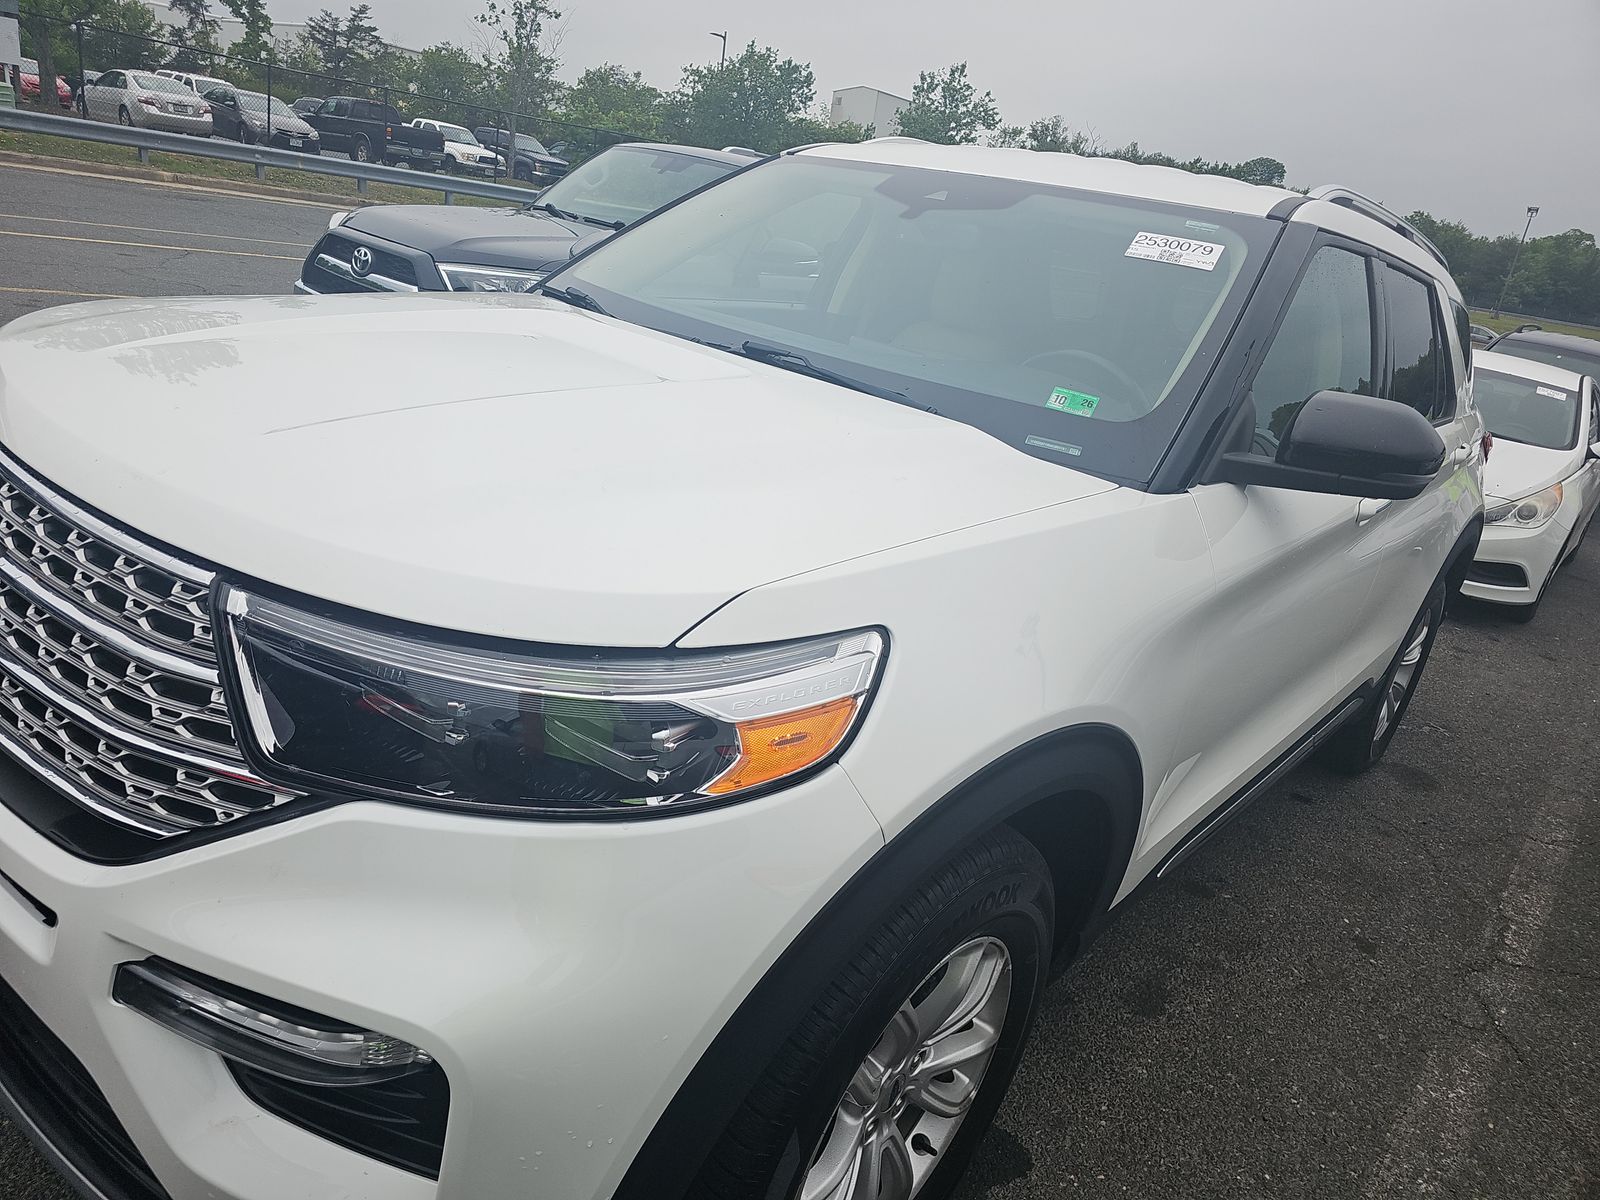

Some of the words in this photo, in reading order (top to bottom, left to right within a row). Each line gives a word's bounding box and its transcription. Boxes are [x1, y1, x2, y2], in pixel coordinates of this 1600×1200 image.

[1134, 234, 1214, 256] 2530079
[1053, 394, 1067, 405] 10
[1081, 398, 1094, 408] 26
[732, 677, 851, 711] EXPLORER
